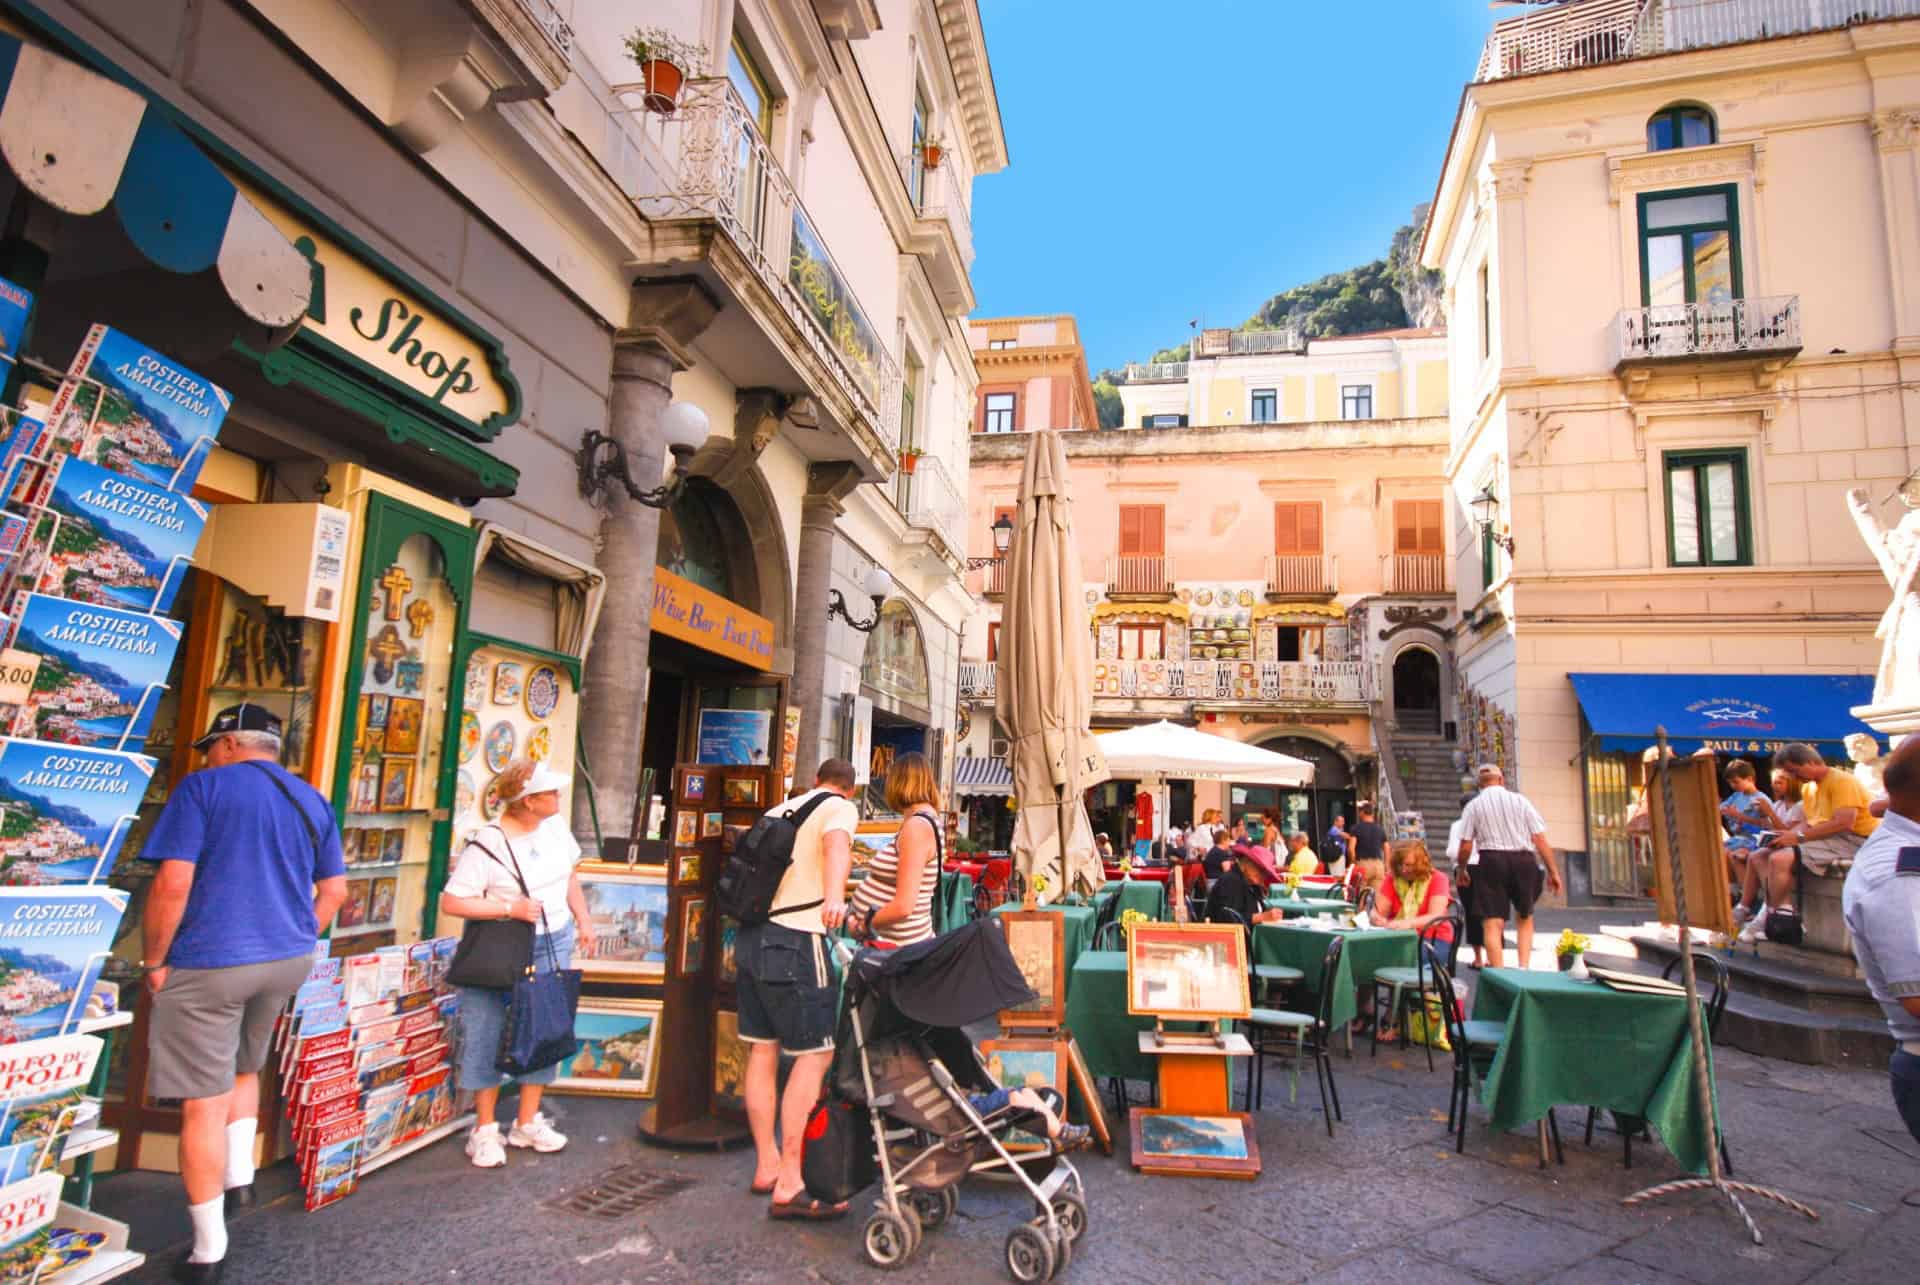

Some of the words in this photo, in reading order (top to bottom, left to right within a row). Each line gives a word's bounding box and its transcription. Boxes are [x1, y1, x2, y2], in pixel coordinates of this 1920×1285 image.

[349, 298, 481, 402] Shop
[115, 362, 211, 418] AMALFITANA
[137, 354, 206, 400] COSTIERA
[78, 489, 185, 533] AMALFITANA
[101, 478, 178, 515] COSTIERA
[67, 610, 150, 637] COSTIERA
[688, 602, 716, 633] Bar
[45, 624, 159, 656] AMALFITANA
[1703, 740, 1744, 752] PAUL
[18, 770, 129, 794] AMALFITANA
[43, 755, 125, 778] COSTIERA
[13, 903, 98, 920] COSTIERA
